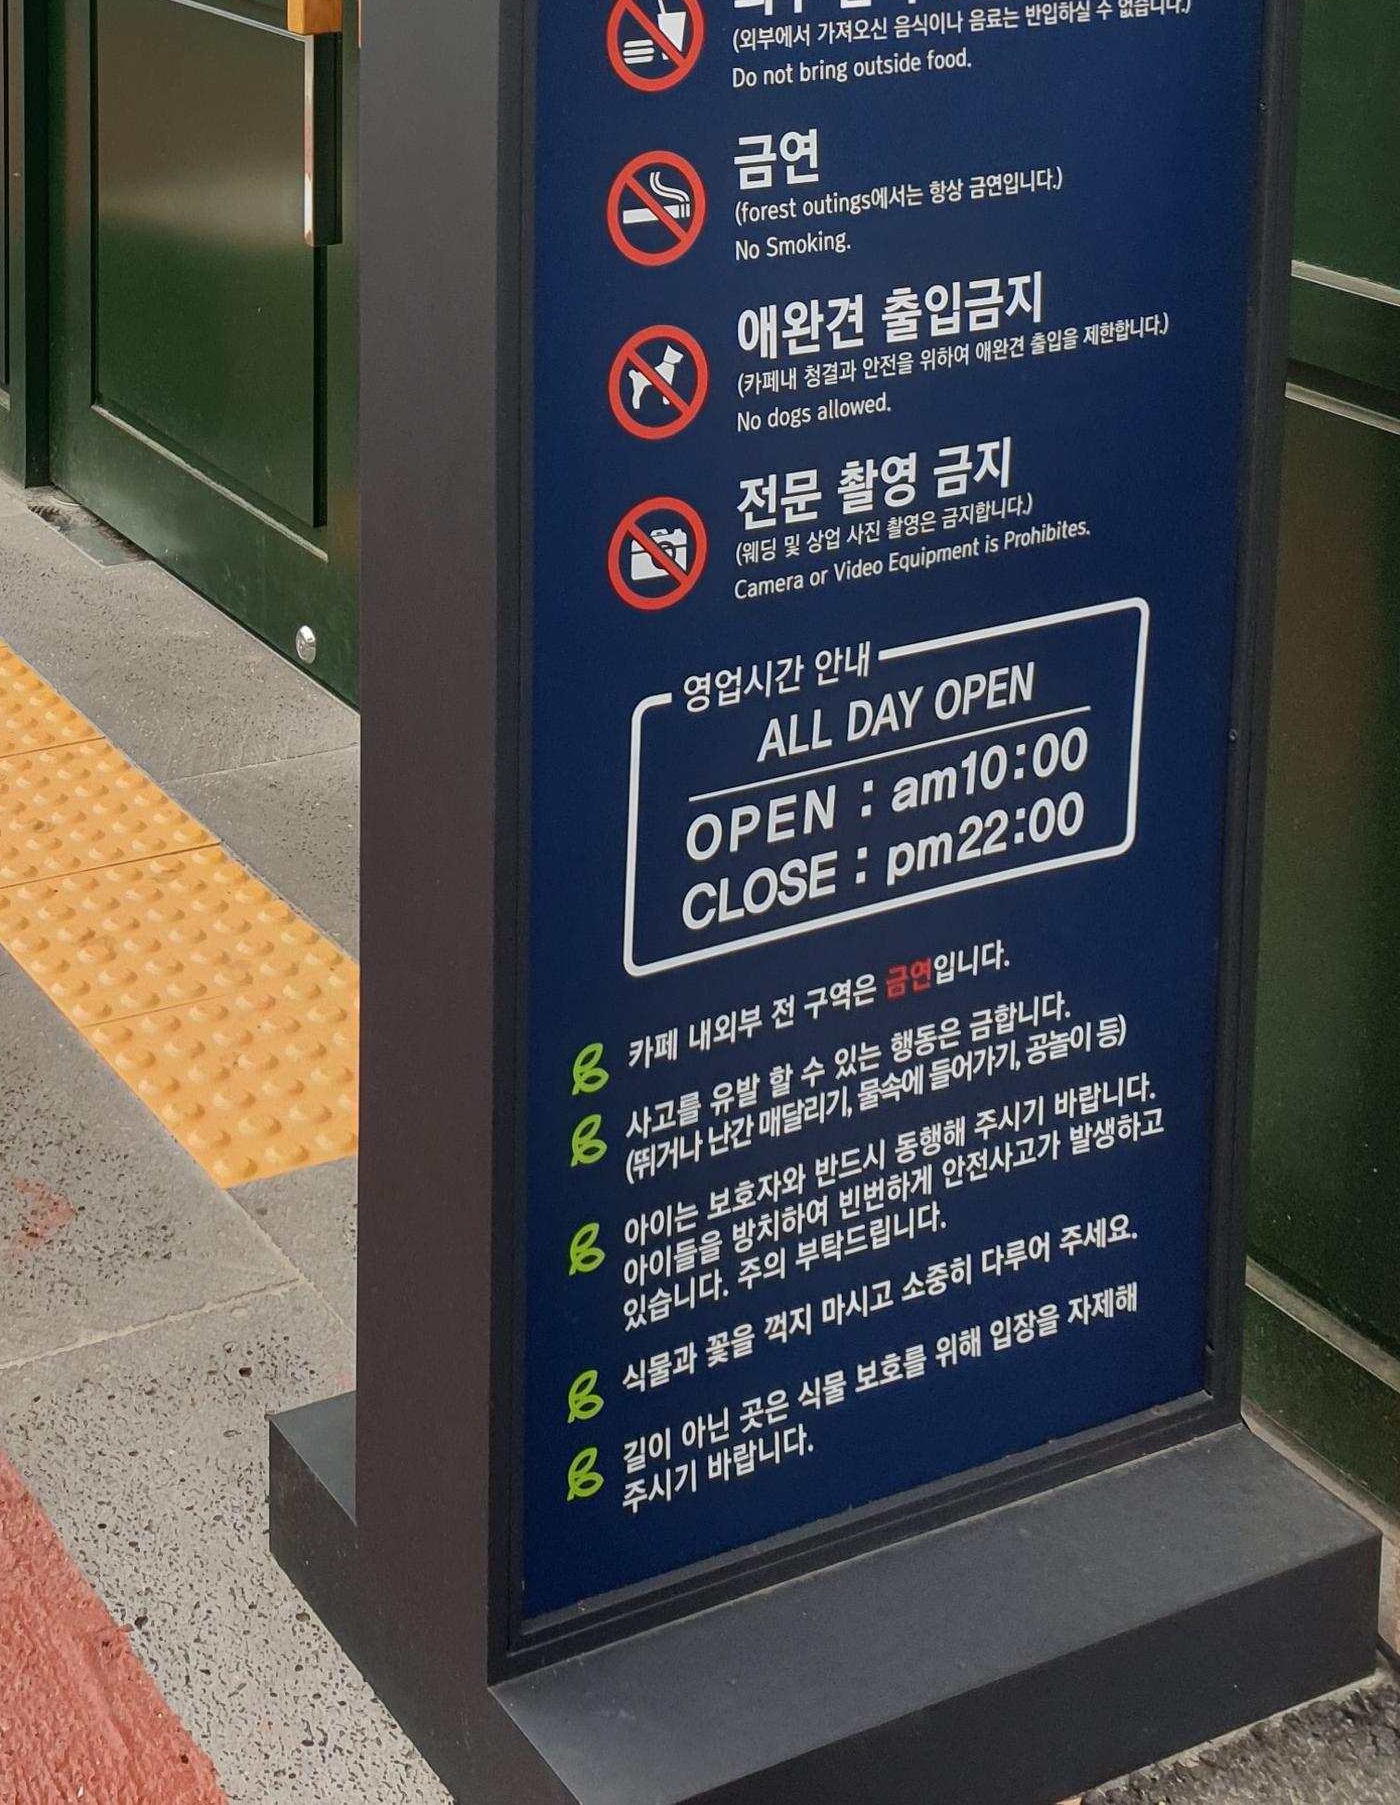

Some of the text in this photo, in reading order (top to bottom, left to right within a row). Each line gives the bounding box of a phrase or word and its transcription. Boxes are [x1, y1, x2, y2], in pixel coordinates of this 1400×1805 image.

[732, 23, 810, 54] (외부에서
[817, 16, 888, 45] 가져오신
[893, 10, 964, 39] 음식이나
[968, 6, 1020, 32] 음료는
[1025, 0, 1091, 27] 반입하실
[732, 46, 972, 88] Do not bring outside food.
[733, 128, 820, 190] 금연
[735, 166, 1063, 227] (forest outings에서는 항상 금연입니다.)
[735, 230, 851, 261] No Smoking.
[737, 270, 1042, 360] 애완견 출입금지
[737, 312, 1169, 399] (카페내 청결과 안전을 위하여 애완견 출입을 제한합니다.)
[737, 391, 892, 432] No dogs allowed.
[735, 492, 1033, 567] (웨딩 및 상업 사진 촬영은 금지합니다.)
[736, 436, 1012, 531] 전문 촬영 금지
[734, 520, 1090, 600] Camera or Video Equipment is Prohibites.
[683, 640, 871, 713] 영업시간 안내
[756, 661, 1035, 763] ALL DAY OPEN
[686, 726, 1088, 861] OPEN am10:00
[682, 791, 1085, 930] CLOSE pm22:00
[628, 939, 1010, 1069] 카페 내외부 전 구역은 금연입니다.
[625, 990, 1071, 1139] 사고를 유발 할 수 있는 행동은 금합니다.
[625, 1013, 1127, 1185] (뛰거나 난간 매달리기, 물속에 들어가기, 공놀이 등)
[623, 1107, 1165, 1287] 아이들을 방치하여 빈번하게 안전사고가 발생하고
[624, 1072, 1156, 1246] 아이는 보호자와 반드시 동행해 주시기 바랍니다.
[622, 1214, 1138, 1392] 식물과 꽃을 꺽지 마시고 소중히 다루어 주세요.
[623, 1200, 947, 1332] 있습니다. 주의 부탁드립니다.
[623, 1281, 1138, 1474] 길이 아닌 곳은 식물 보호를 위해 입장을 자제해
[622, 1423, 814, 1514] 주시기 바랍니다.
